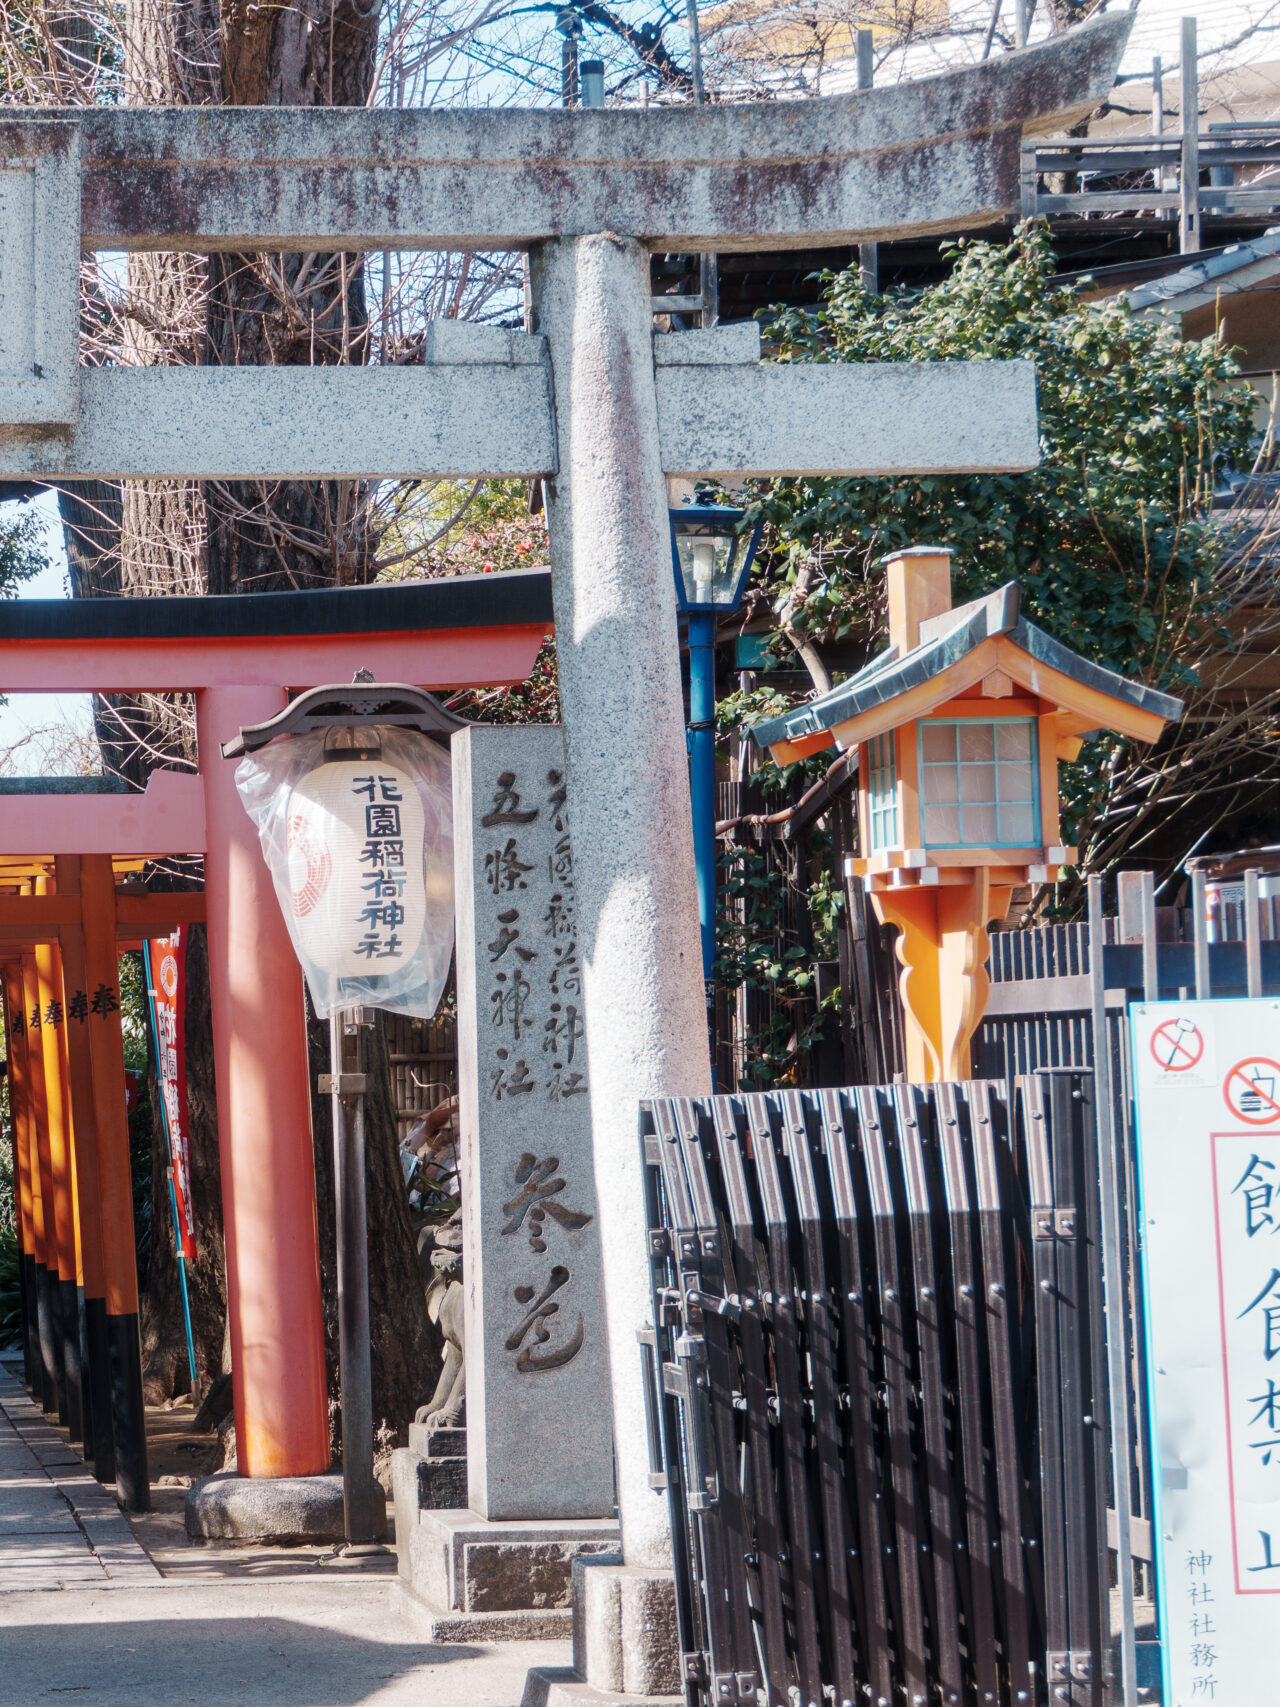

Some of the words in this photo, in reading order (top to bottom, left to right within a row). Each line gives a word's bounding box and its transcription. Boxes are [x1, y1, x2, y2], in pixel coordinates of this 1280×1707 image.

[352, 775, 404, 960] 花園稲荷神社
[90, 984, 119, 1020] 奉
[1184, 1549, 1219, 1699] 神社社務所
